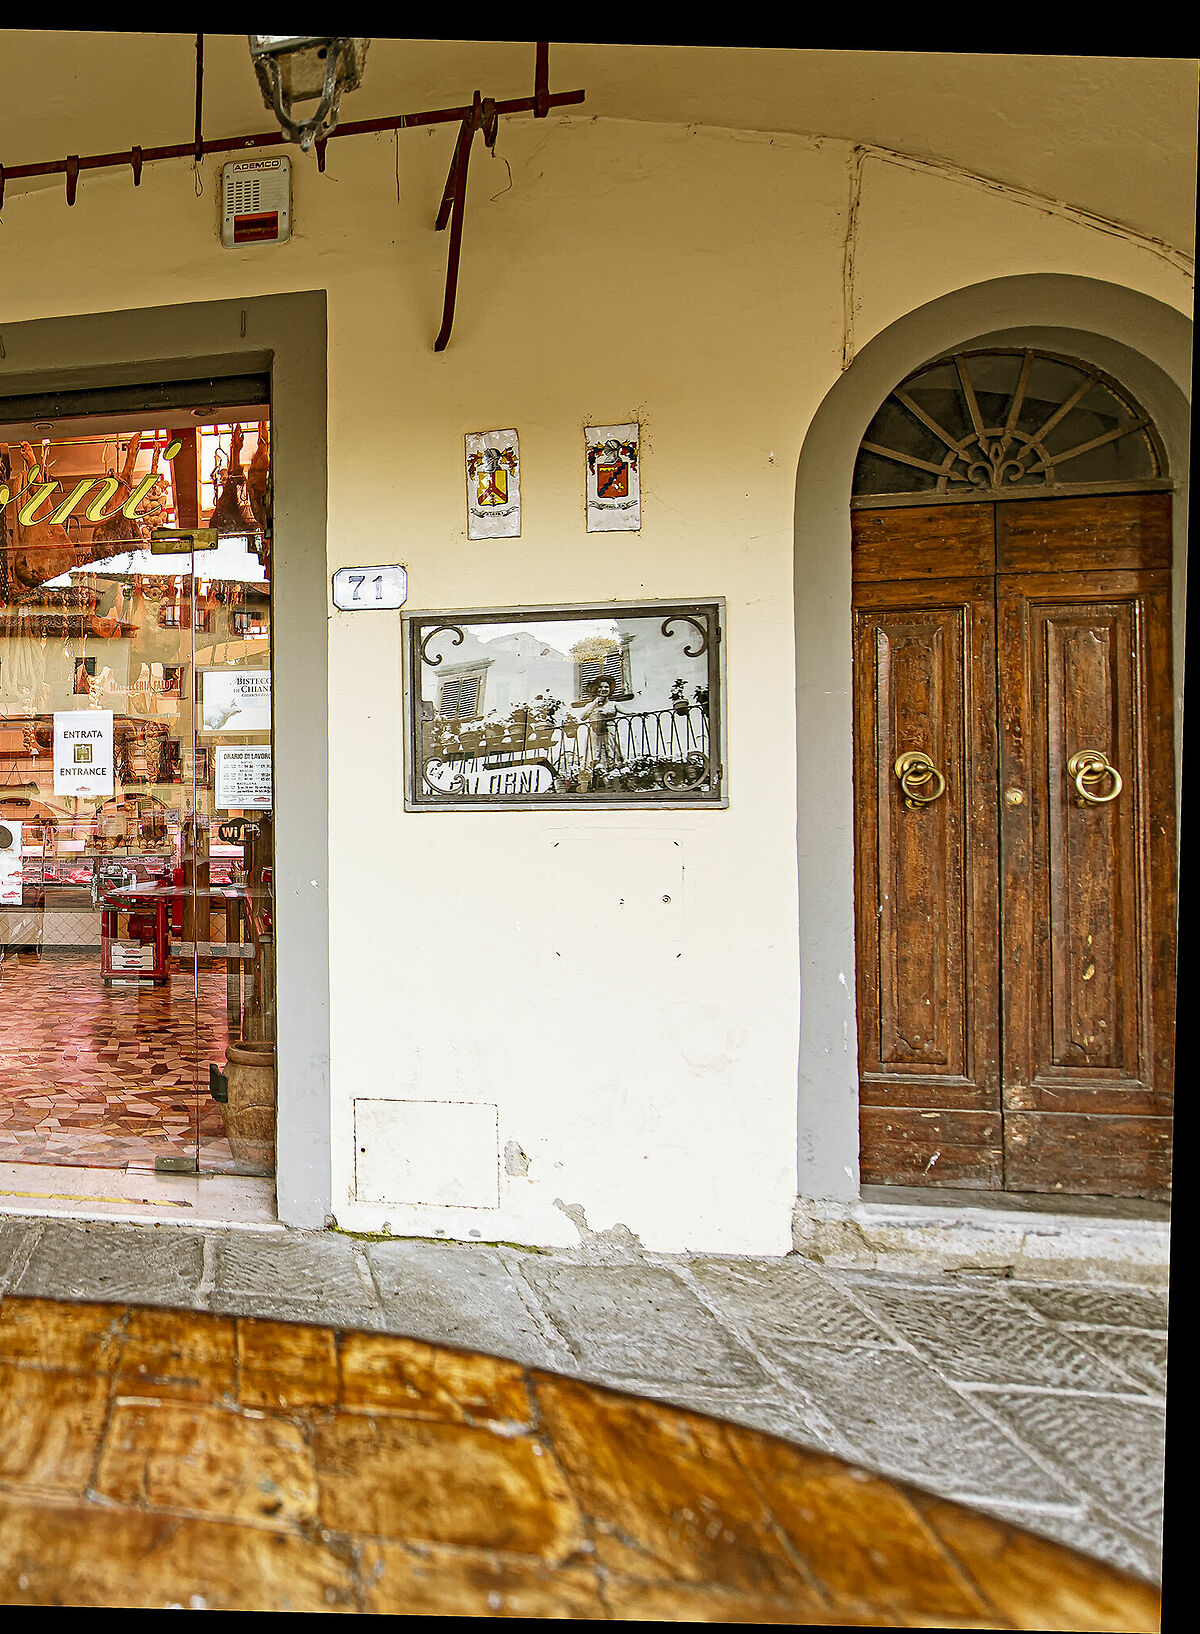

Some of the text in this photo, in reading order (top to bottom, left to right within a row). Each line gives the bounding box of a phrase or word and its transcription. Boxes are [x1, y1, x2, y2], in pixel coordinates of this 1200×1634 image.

[234, 160, 280, 171] ADEMCO
[348, 575, 383, 601] 71
[63, 730, 103, 739] ENTRATA
[60, 767, 107, 777] ENTRANCE
